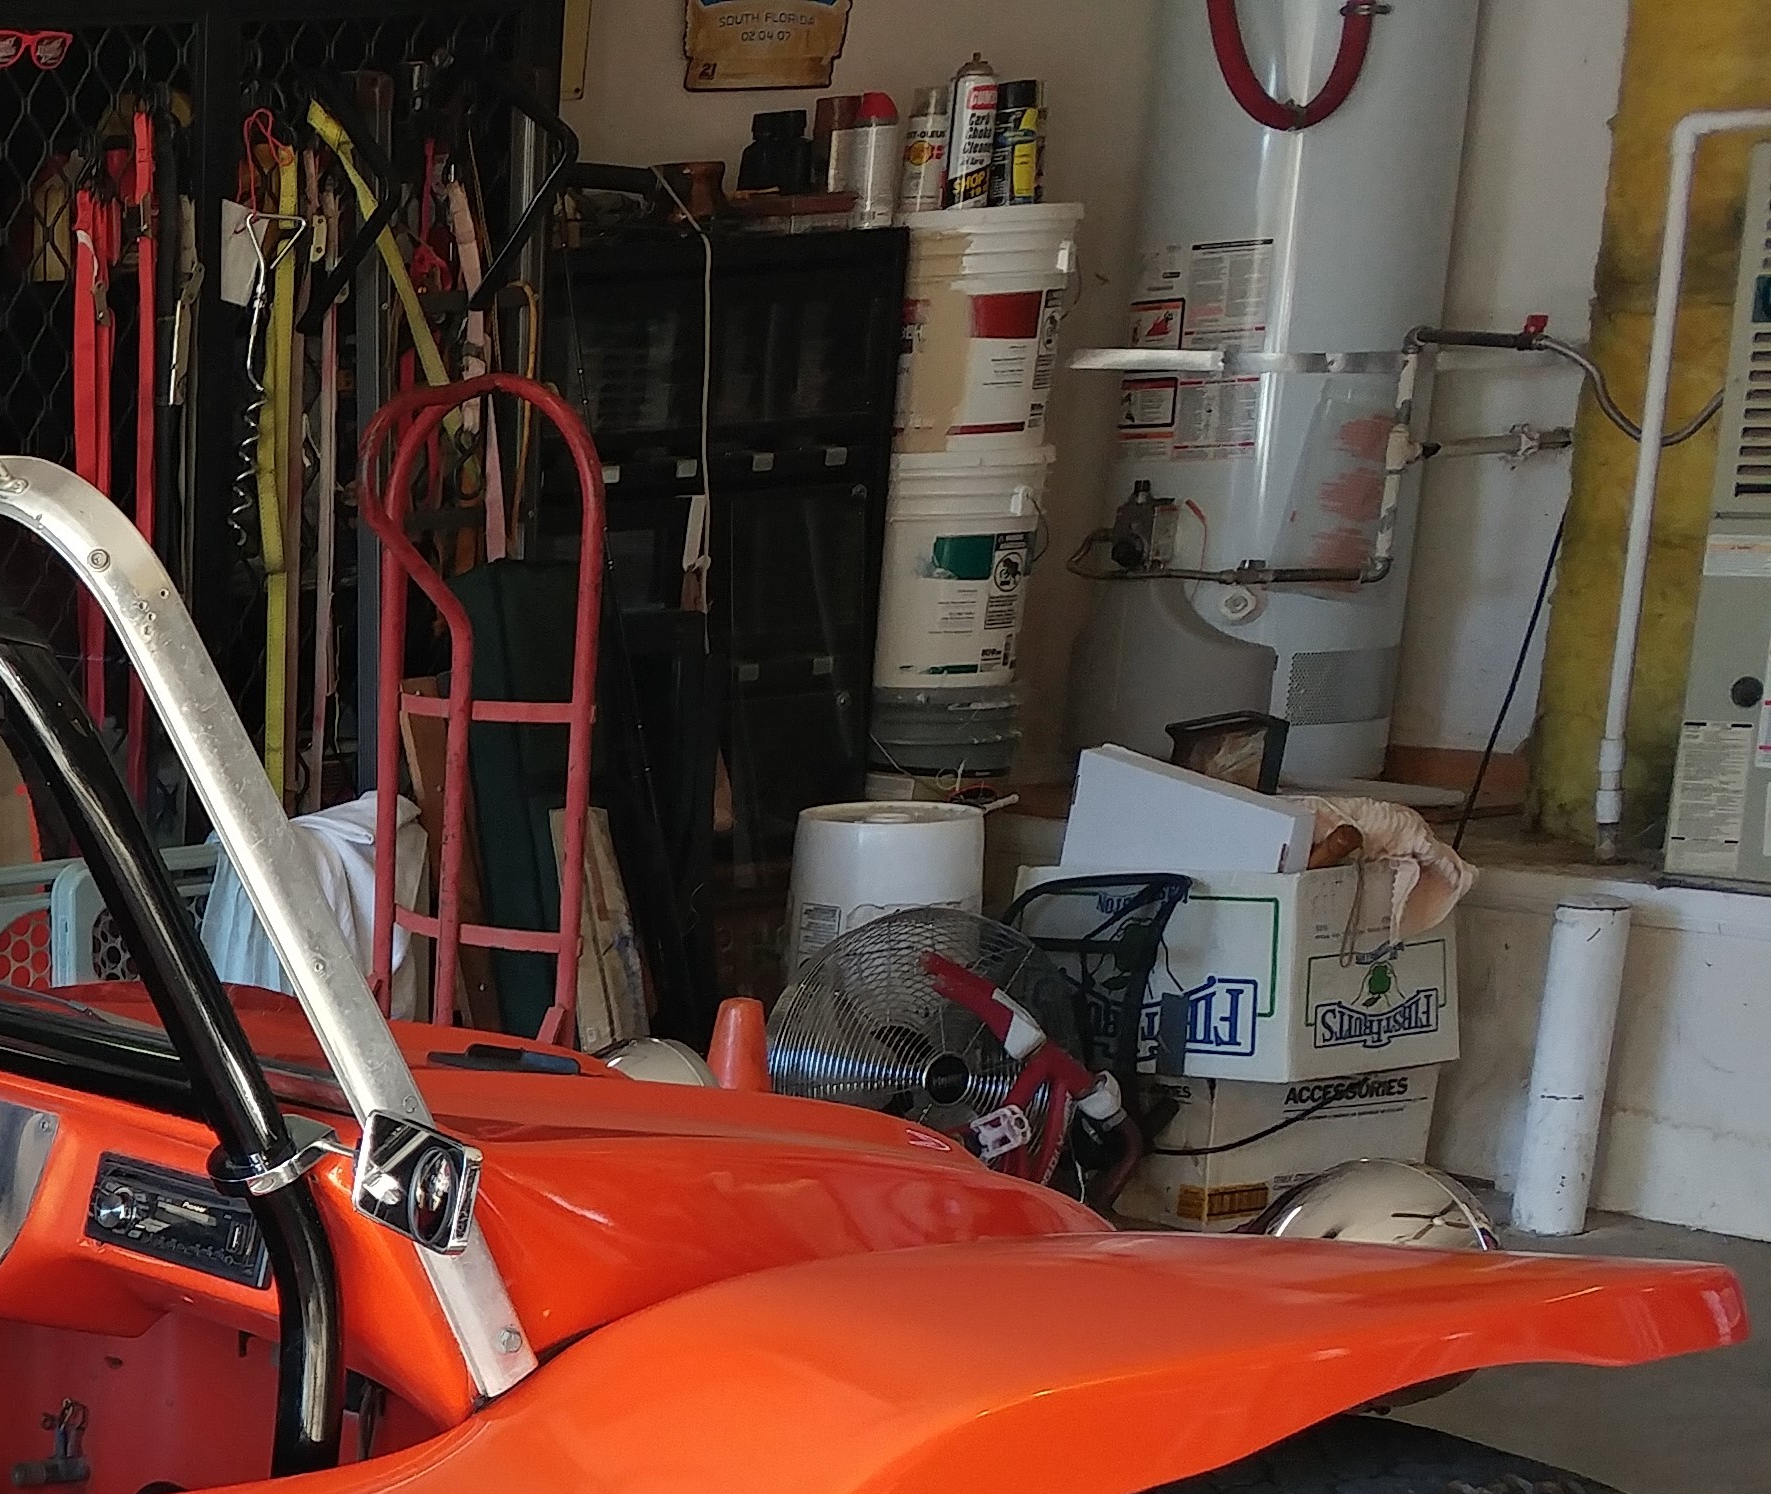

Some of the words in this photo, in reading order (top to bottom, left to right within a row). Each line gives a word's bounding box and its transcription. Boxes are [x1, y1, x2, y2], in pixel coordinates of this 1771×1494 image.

[719, 13, 759, 28] SOUTH
[765, 12, 816, 26] FLORIDA
[1285, 1077, 1409, 1106] ACCESSORIES
